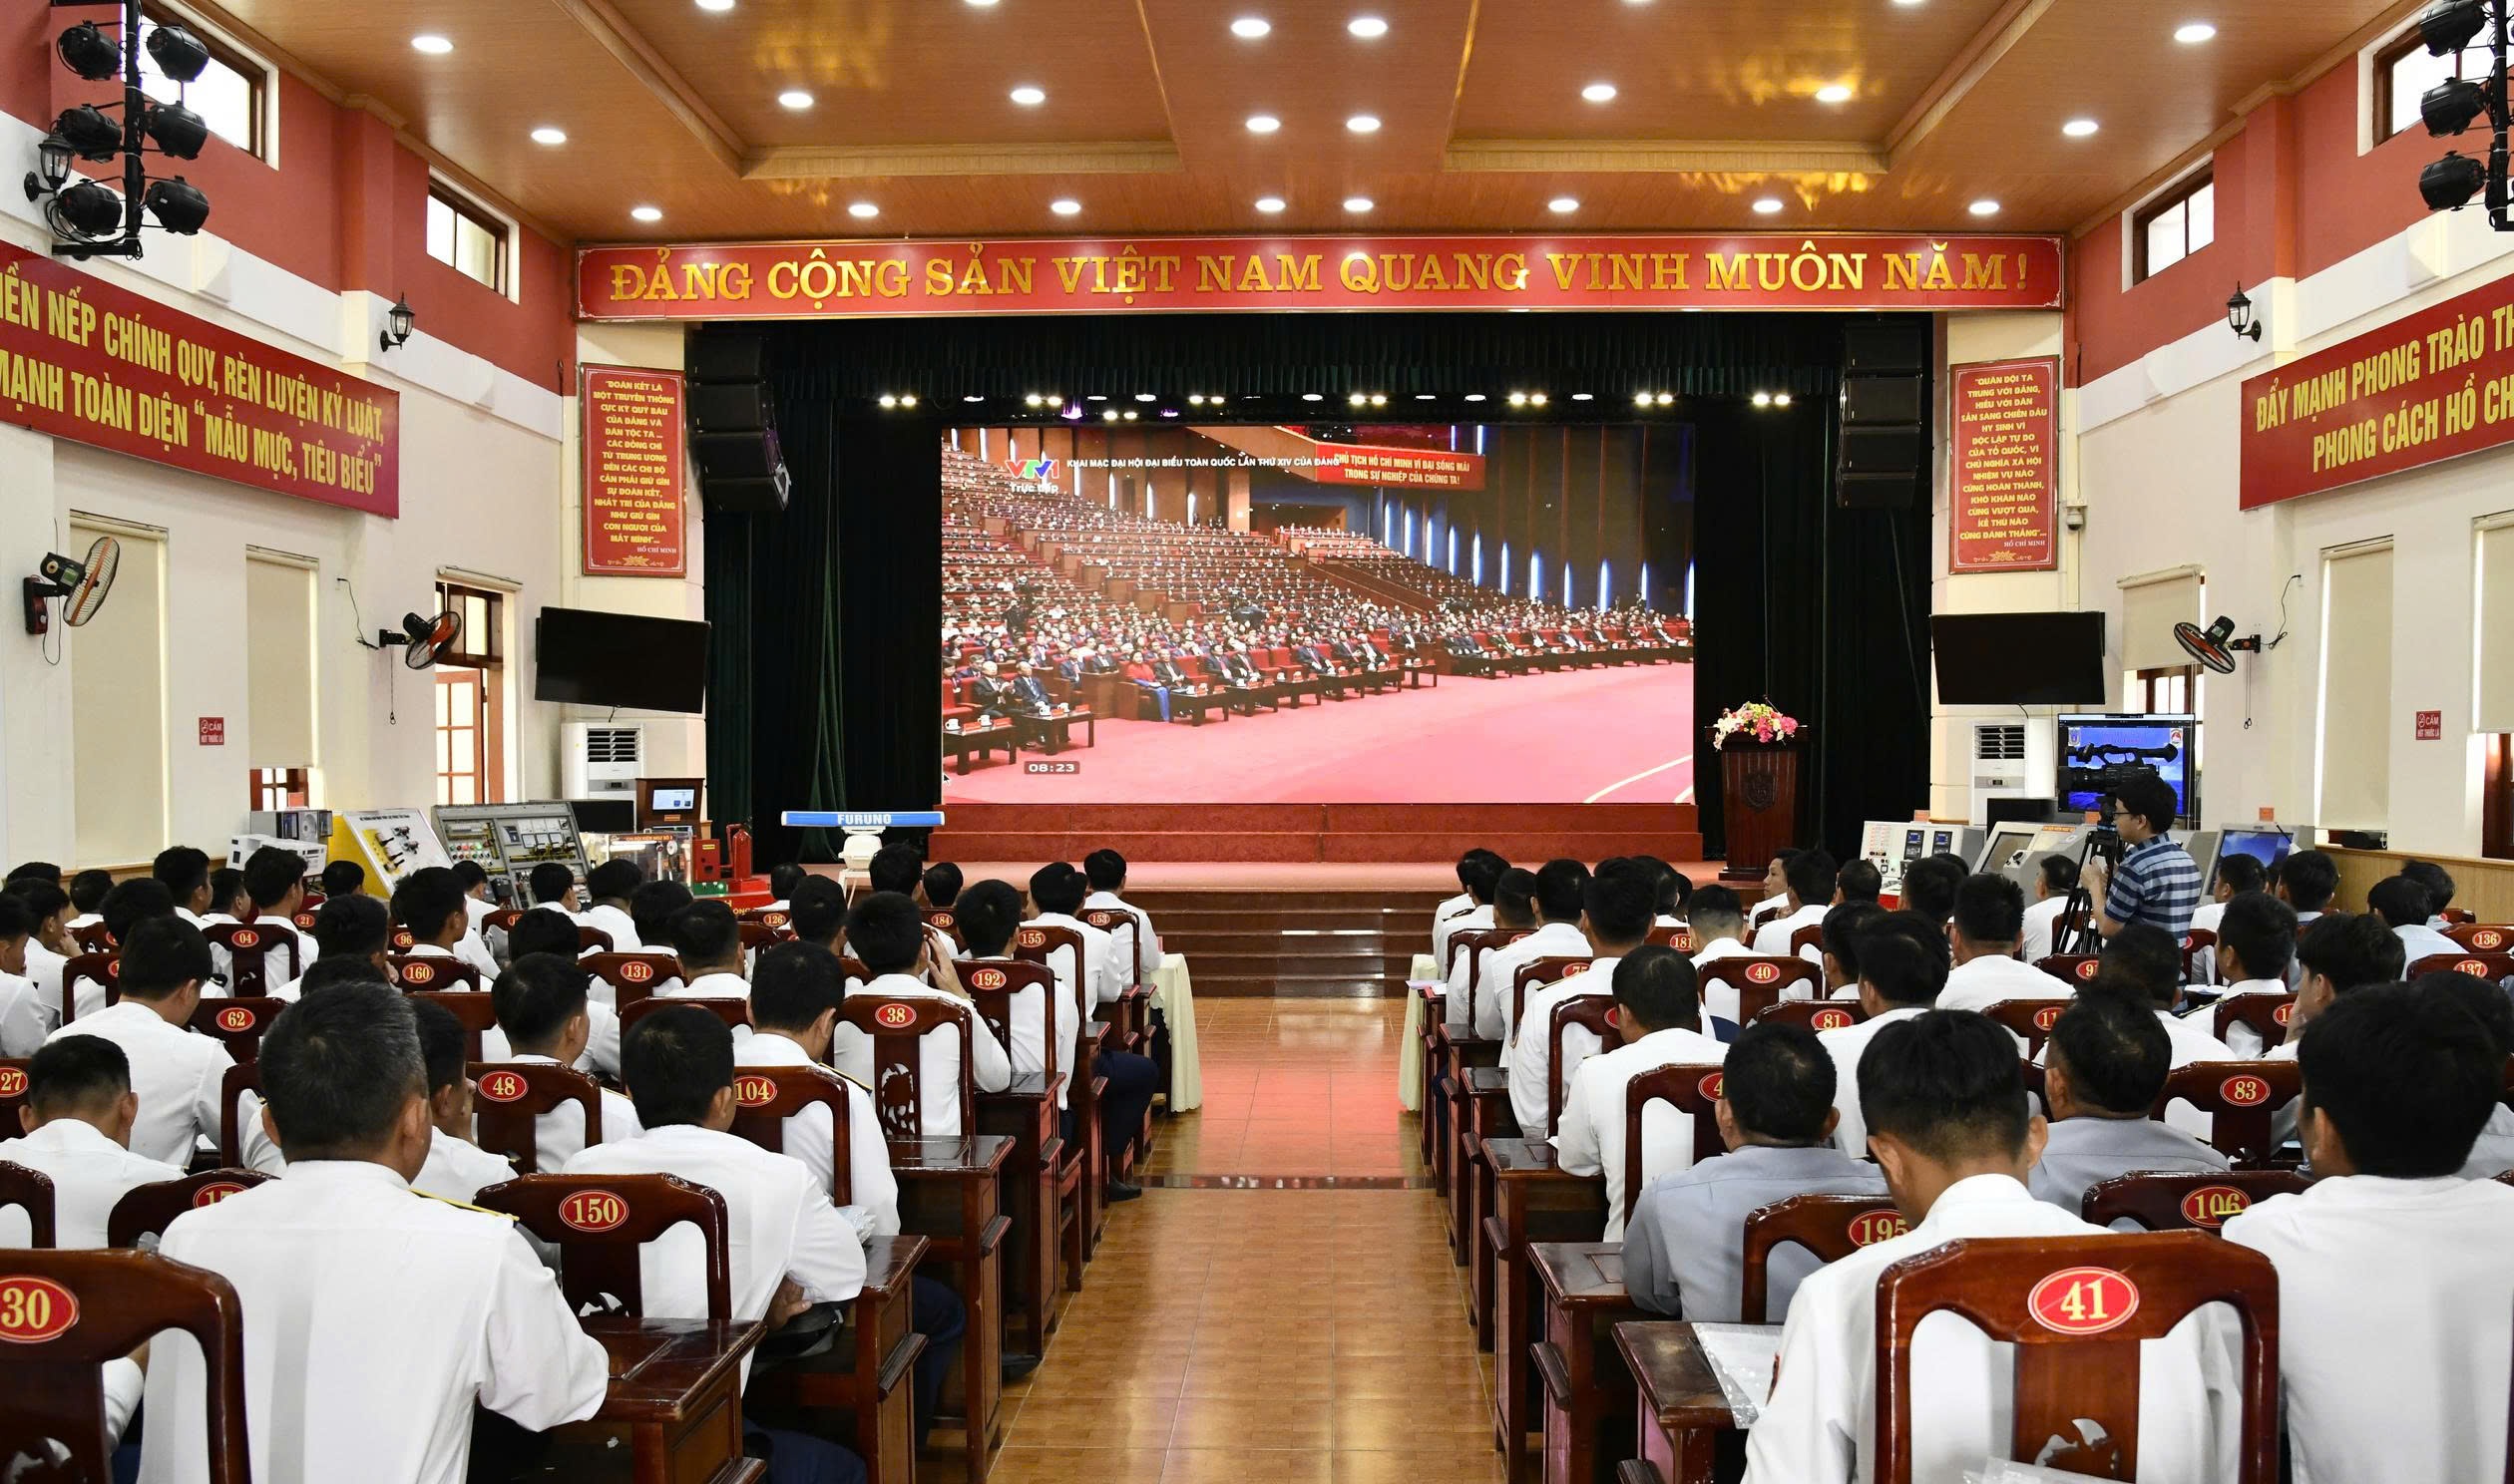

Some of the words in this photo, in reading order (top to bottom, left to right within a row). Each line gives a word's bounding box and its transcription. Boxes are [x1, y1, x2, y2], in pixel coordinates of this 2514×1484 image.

[611, 247, 754, 300] ĐẢNG
[768, 248, 911, 310] CỘNG
[925, 243, 1034, 296] SẢN
[1052, 244, 1179, 304] VIỆT
[1198, 254, 1322, 293] NAM
[1340, 253, 1530, 294] QUANG
[1546, 253, 1689, 291] VINH
[1704, 241, 1867, 291] MUÔN
[48, 286, 96, 347] NẾP
[104, 313, 171, 375] CHÍNH
[178, 338, 218, 396] QUY,
[224, 351, 260, 404] RÈN
[265, 371, 317, 427] LUYỆN
[322, 382, 343, 429] KỶ
[347, 398, 384, 447] LUẬT,
[2257, 377, 2289, 432] ĐẨY
[2294, 367, 2345, 422] MẠNH
[2352, 340, 2420, 401] PHONG
[2427, 314, 2484, 374] TRÀO
[72, 372, 132, 432] TOÀN
[139, 391, 188, 453] DIỆN
[254, 426, 297, 481] MỰC,
[302, 439, 336, 485] TIÊU
[2313, 419, 2376, 473] PHONG
[2382, 400, 2438, 453] CÁCH
[2446, 373, 2476, 436] HỒ
[1089, 459, 1108, 469] MẠC
[1128, 458, 1142, 468] HỘI
[1185, 457, 1208, 467] TOÀN
[1211, 456, 1235, 467] QUỐC
[838, 814, 891, 825] FURUNO
[300, 915, 310, 927] 21
[767, 915, 783, 926] 126
[935, 915, 950, 926] 184
[1092, 914, 1107, 925] 153
[239, 932, 252, 944] 04
[401, 932, 412, 944] 96
[1023, 932, 1043, 945] 155
[2478, 932, 2497, 944] 136
[408, 966, 430, 980] 160
[626, 964, 648, 978] 131
[977, 972, 1001, 986] 192
[1755, 966, 1771, 979] 40
[226, 1011, 245, 1027] 62
[887, 1007, 906, 1023] 38
[1824, 1013, 1841, 1028] 81
[1, 1073, 22, 1091] 27
[492, 1076, 515, 1095] 48
[2234, 1081, 2257, 1099] 83
[735, 1081, 769, 1101] 104
[572, 1200, 618, 1224] 150
[2196, 1194, 2241, 1219] 106
[1862, 1219, 1907, 1245] 195
[2060, 1281, 2108, 1320] 41
[1, 1289, 51, 1330] 30
